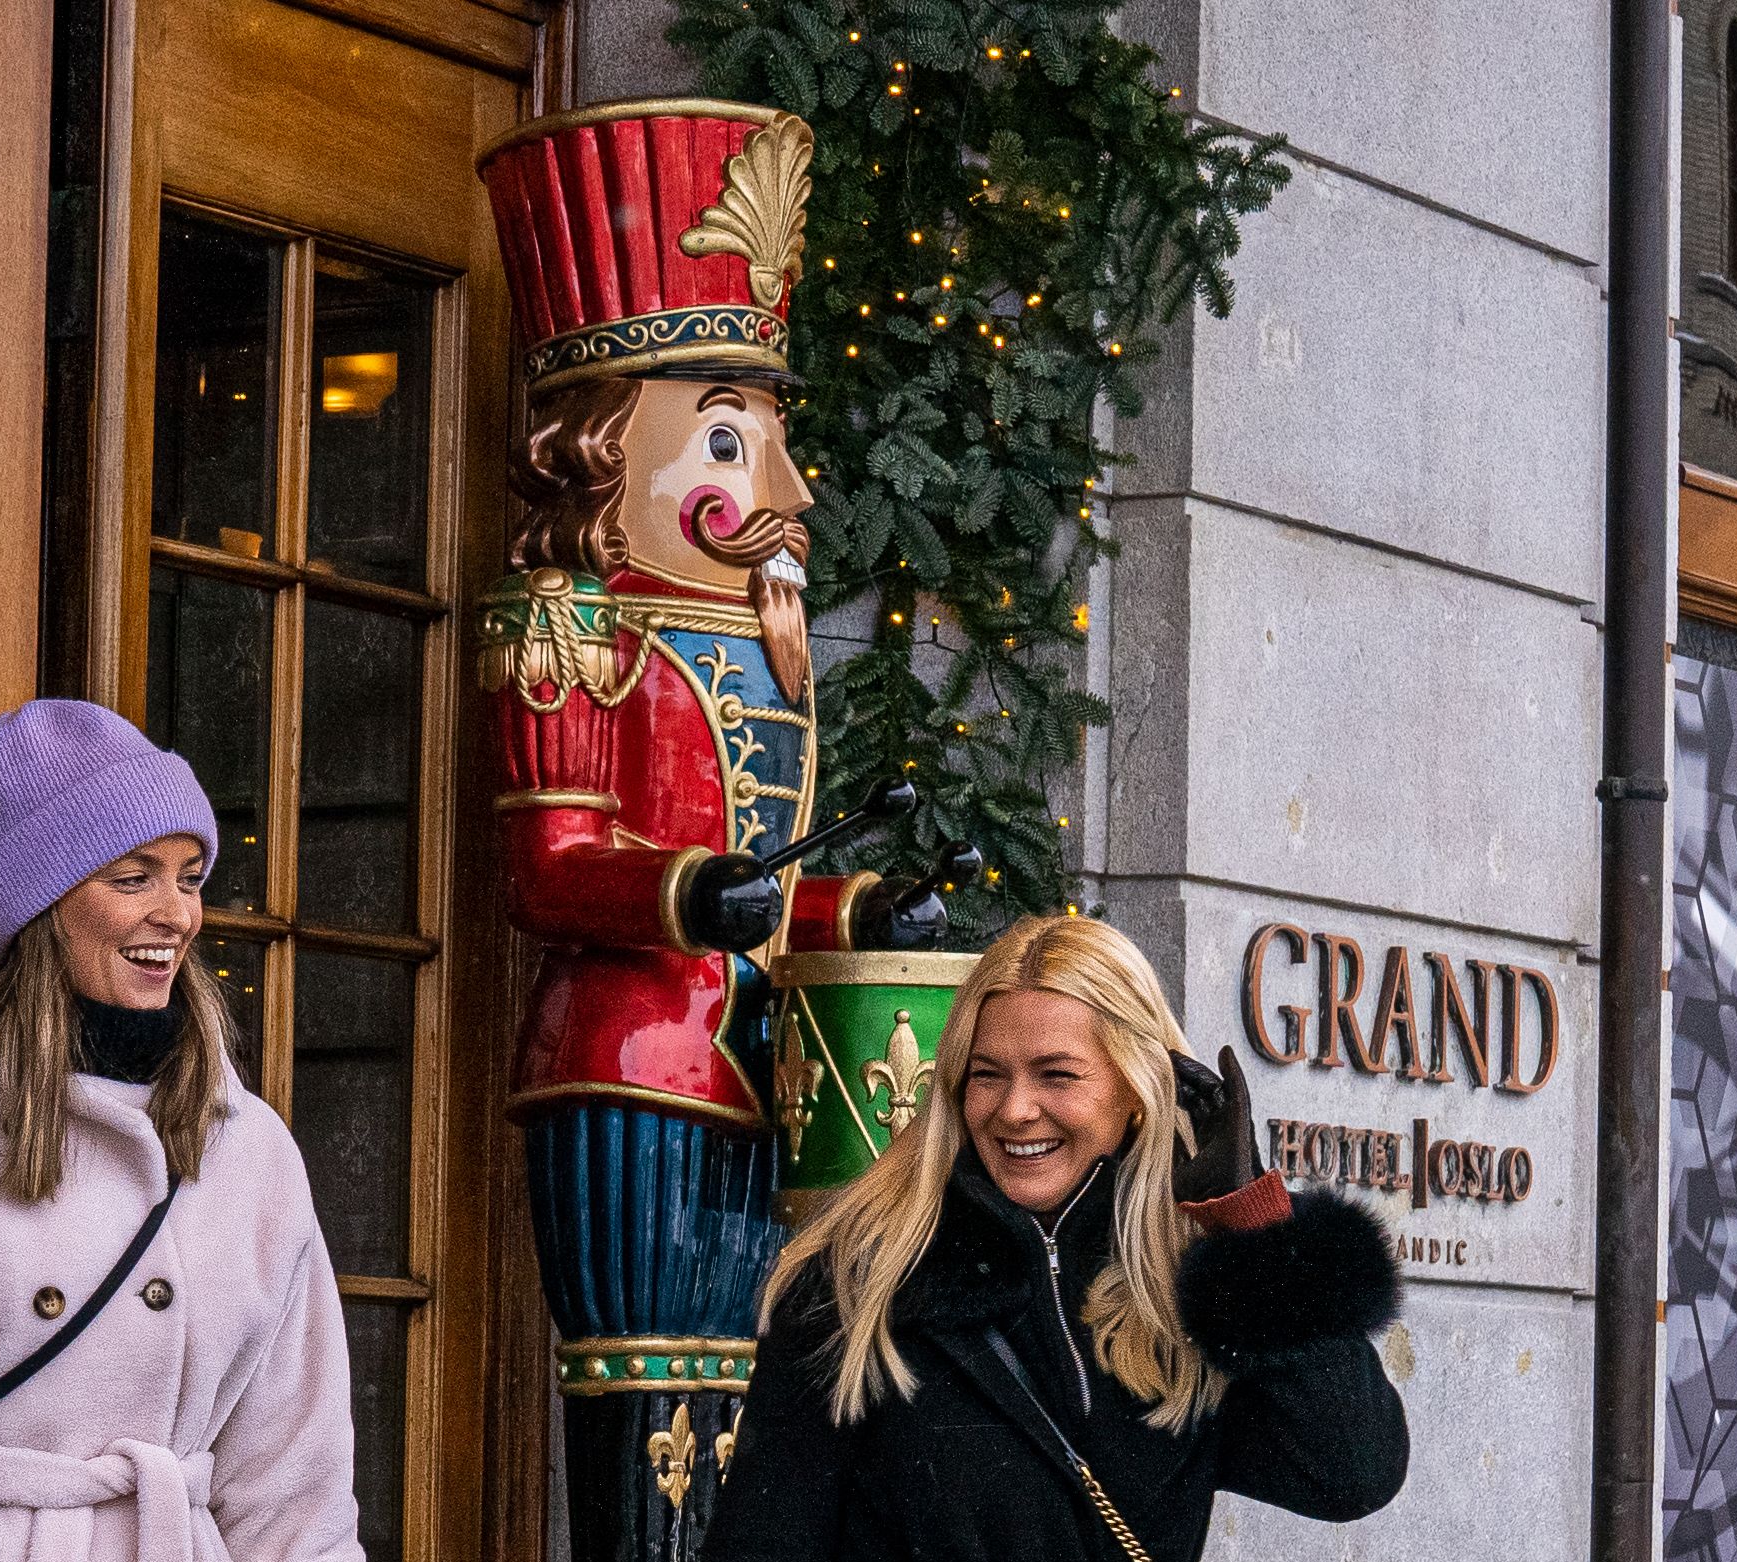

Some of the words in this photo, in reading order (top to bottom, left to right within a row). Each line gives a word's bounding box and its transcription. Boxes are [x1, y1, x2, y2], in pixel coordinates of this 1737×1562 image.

[1241, 923, 1559, 1094] GRAND
[1268, 1118, 1411, 1191] HOTEL
[1428, 1138, 1533, 1201] OSLO
[1396, 1234, 1468, 1265] ANDIC
